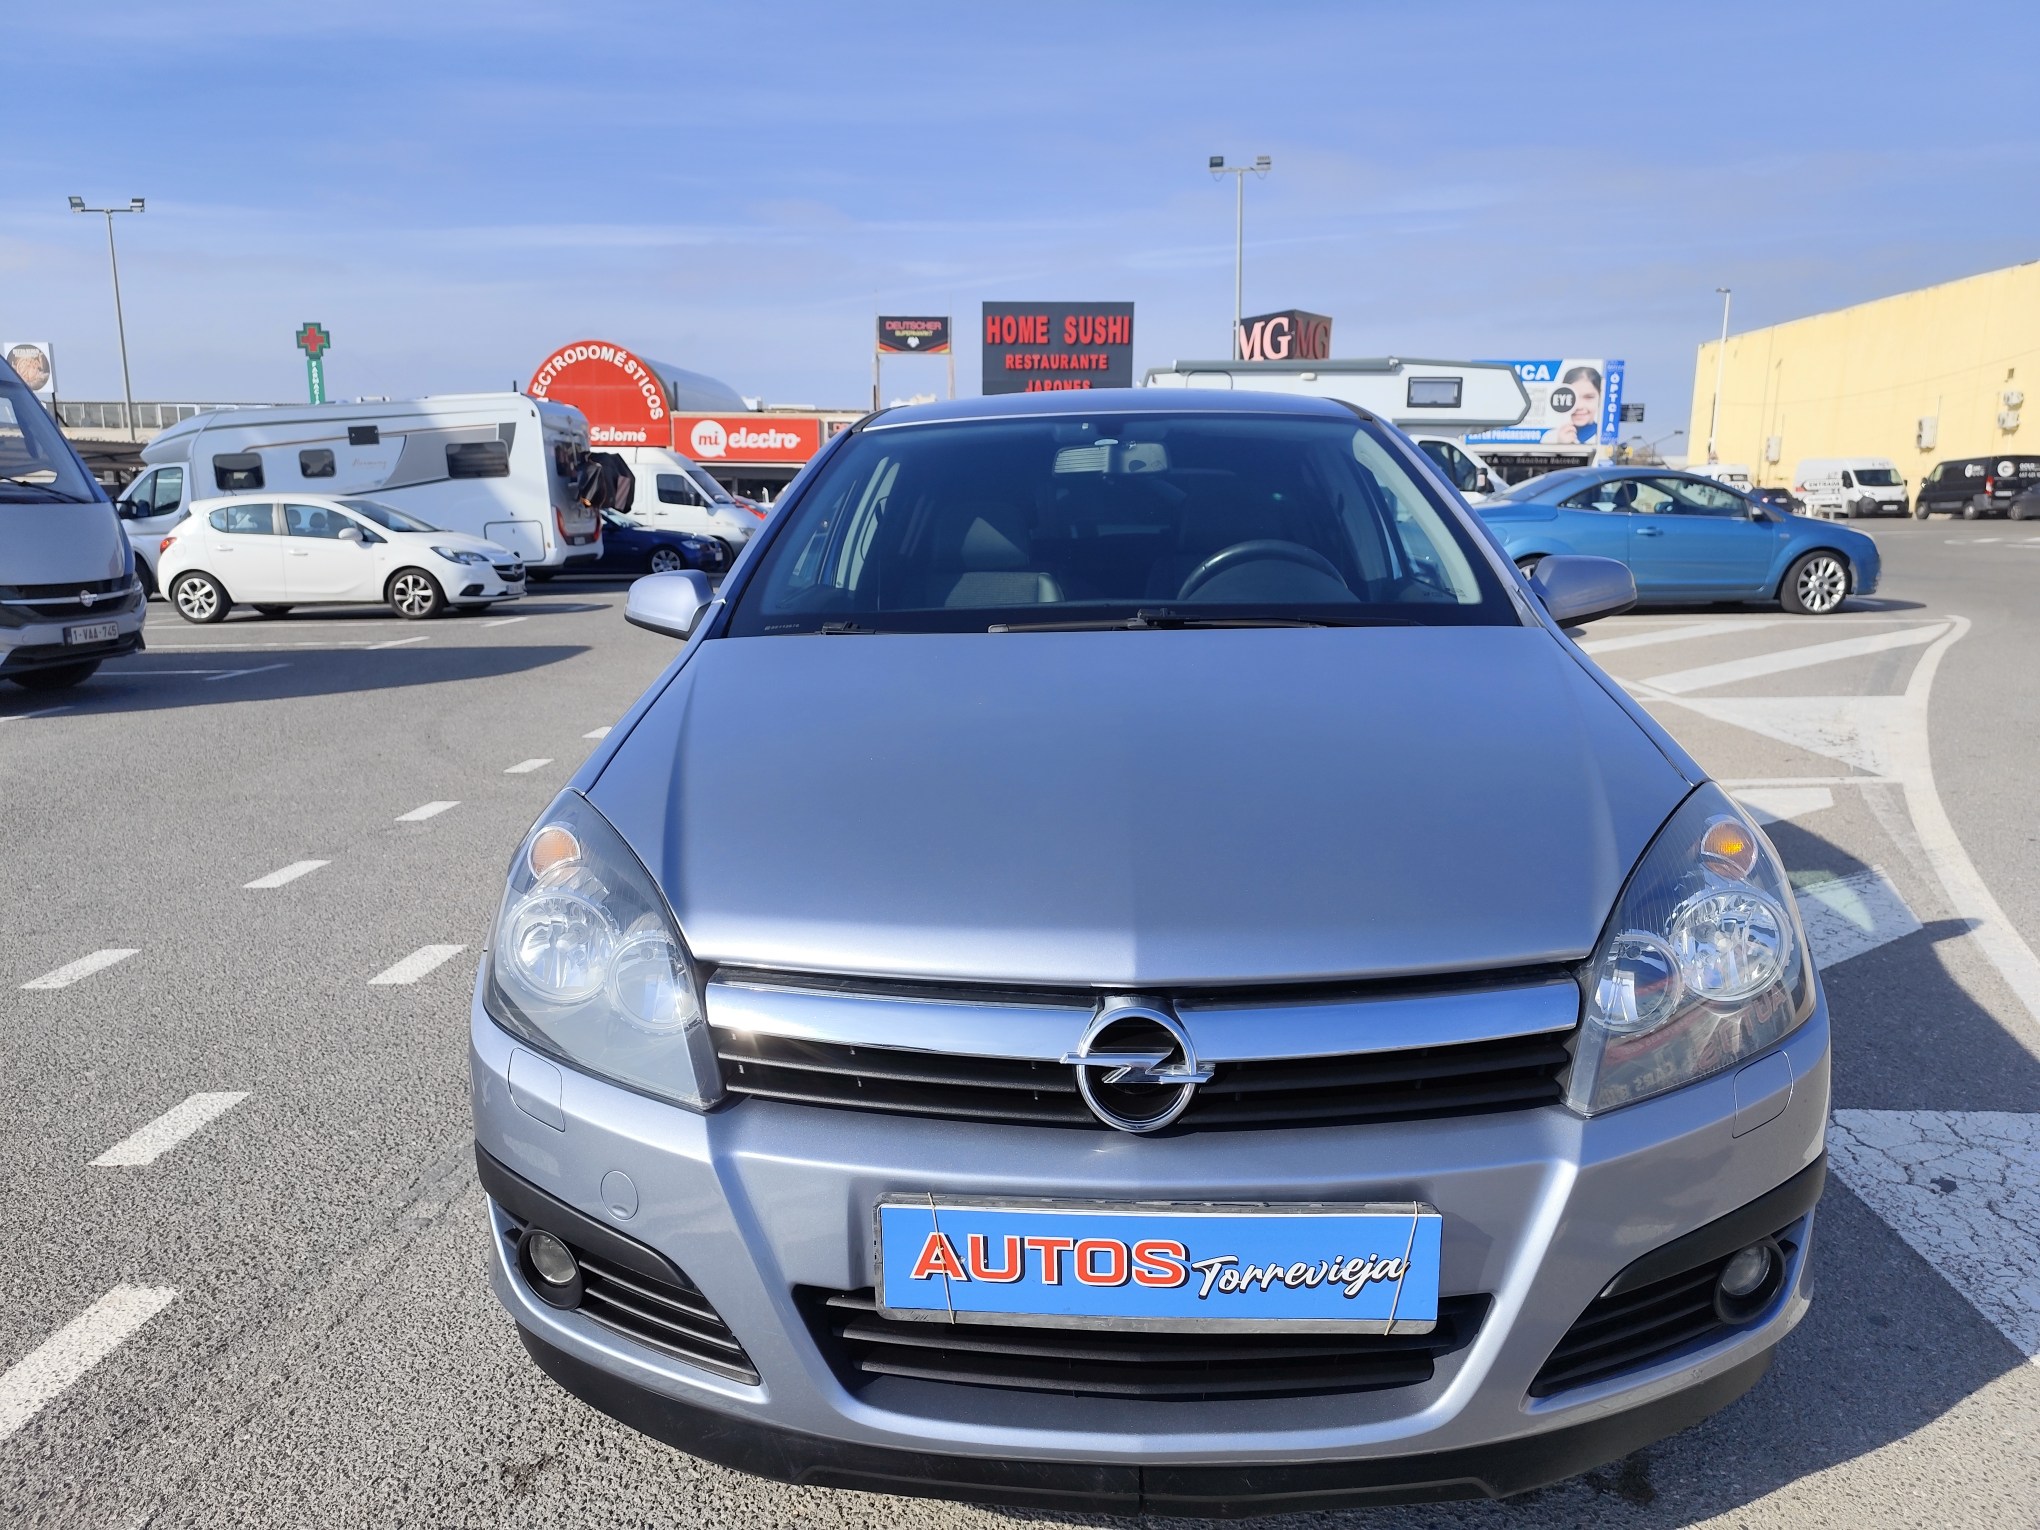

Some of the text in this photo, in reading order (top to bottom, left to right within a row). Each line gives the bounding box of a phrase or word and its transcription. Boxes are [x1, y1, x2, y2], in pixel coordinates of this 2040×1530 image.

[885, 321, 942, 331] DEUTSCHER
[986, 315, 1130, 344] HOME SUSHI
[1240, 316, 1292, 361] MG
[1295, 319, 1329, 360] MG
[1006, 354, 1108, 370] RESTAURANTE
[1025, 379, 1092, 393] JAPONES
[1552, 394, 1573, 406] EYE
[590, 427, 647, 442] Salomé
[698, 427, 801, 449] mi electro
[909, 1232, 1411, 1299] AUTOS Torrevieja
